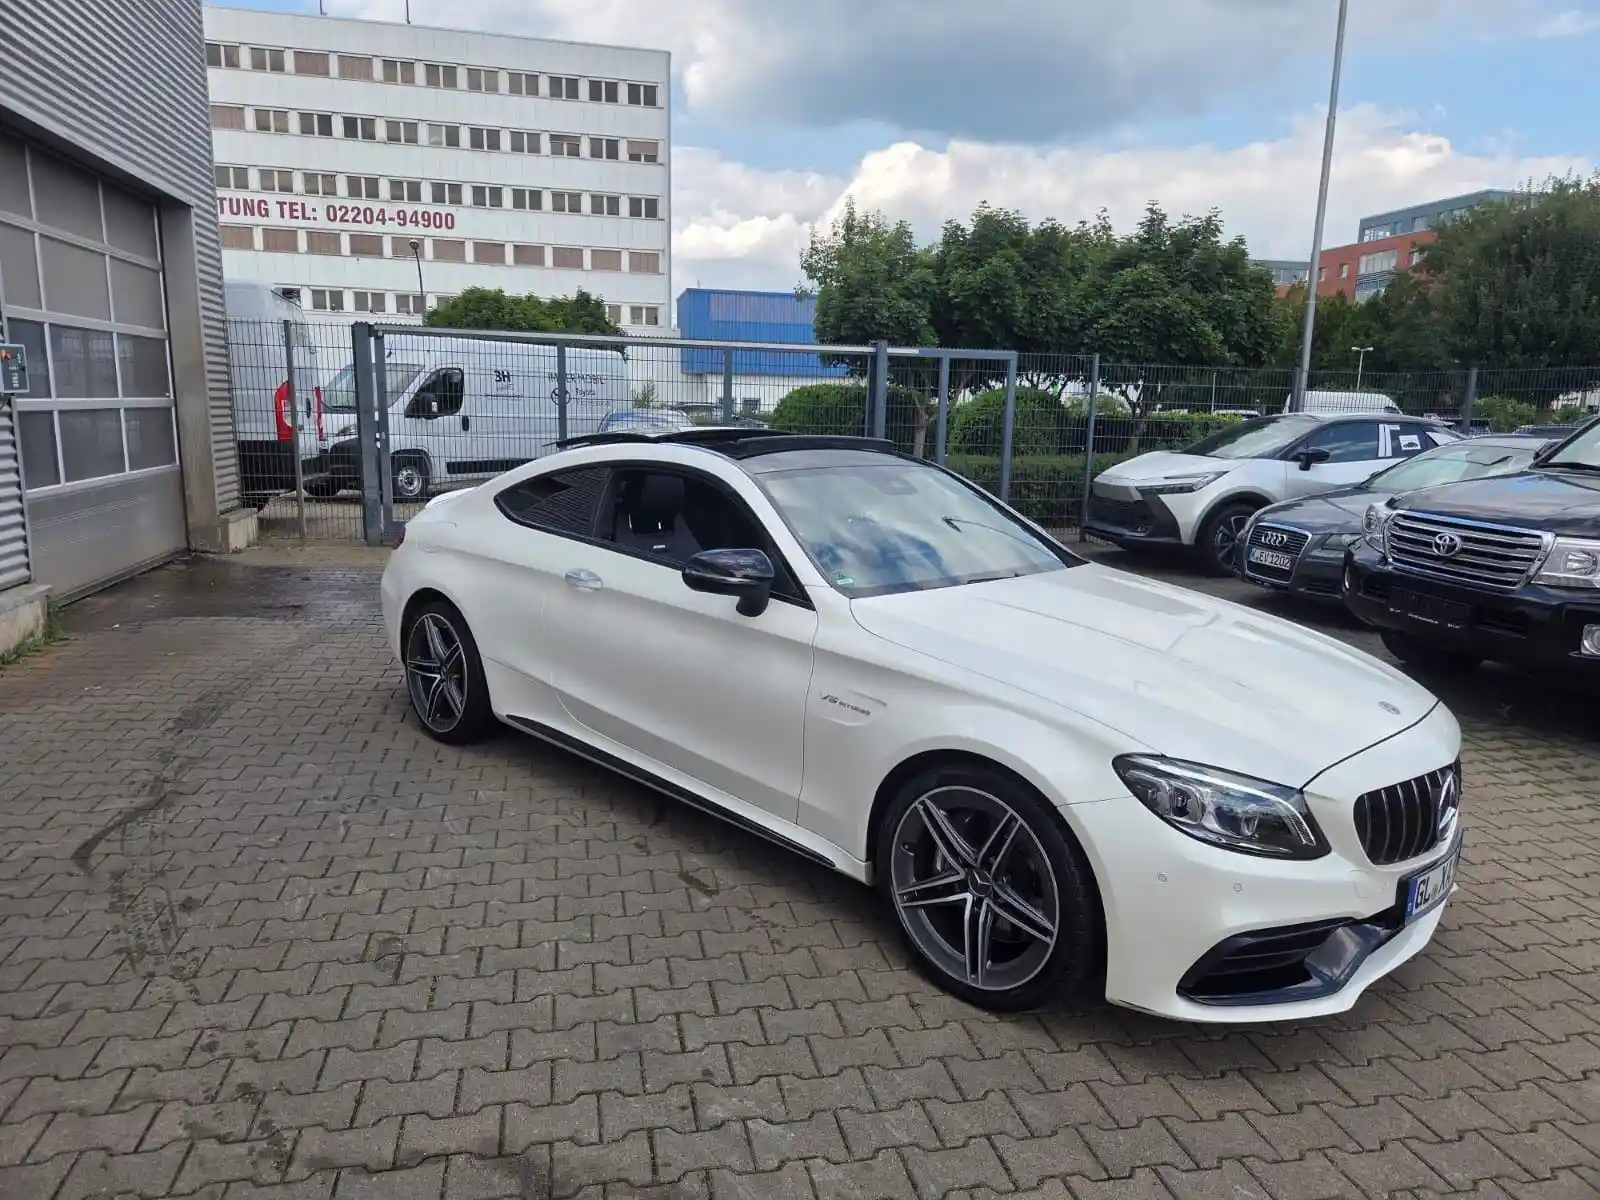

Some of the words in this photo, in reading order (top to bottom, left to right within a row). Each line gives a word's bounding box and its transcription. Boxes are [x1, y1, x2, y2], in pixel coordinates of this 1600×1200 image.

[217, 196, 270, 218] TUNG
[276, 200, 317, 221] TEL:
[325, 204, 455, 229] 02204-94900
[1415, 875, 1431, 909] GL
